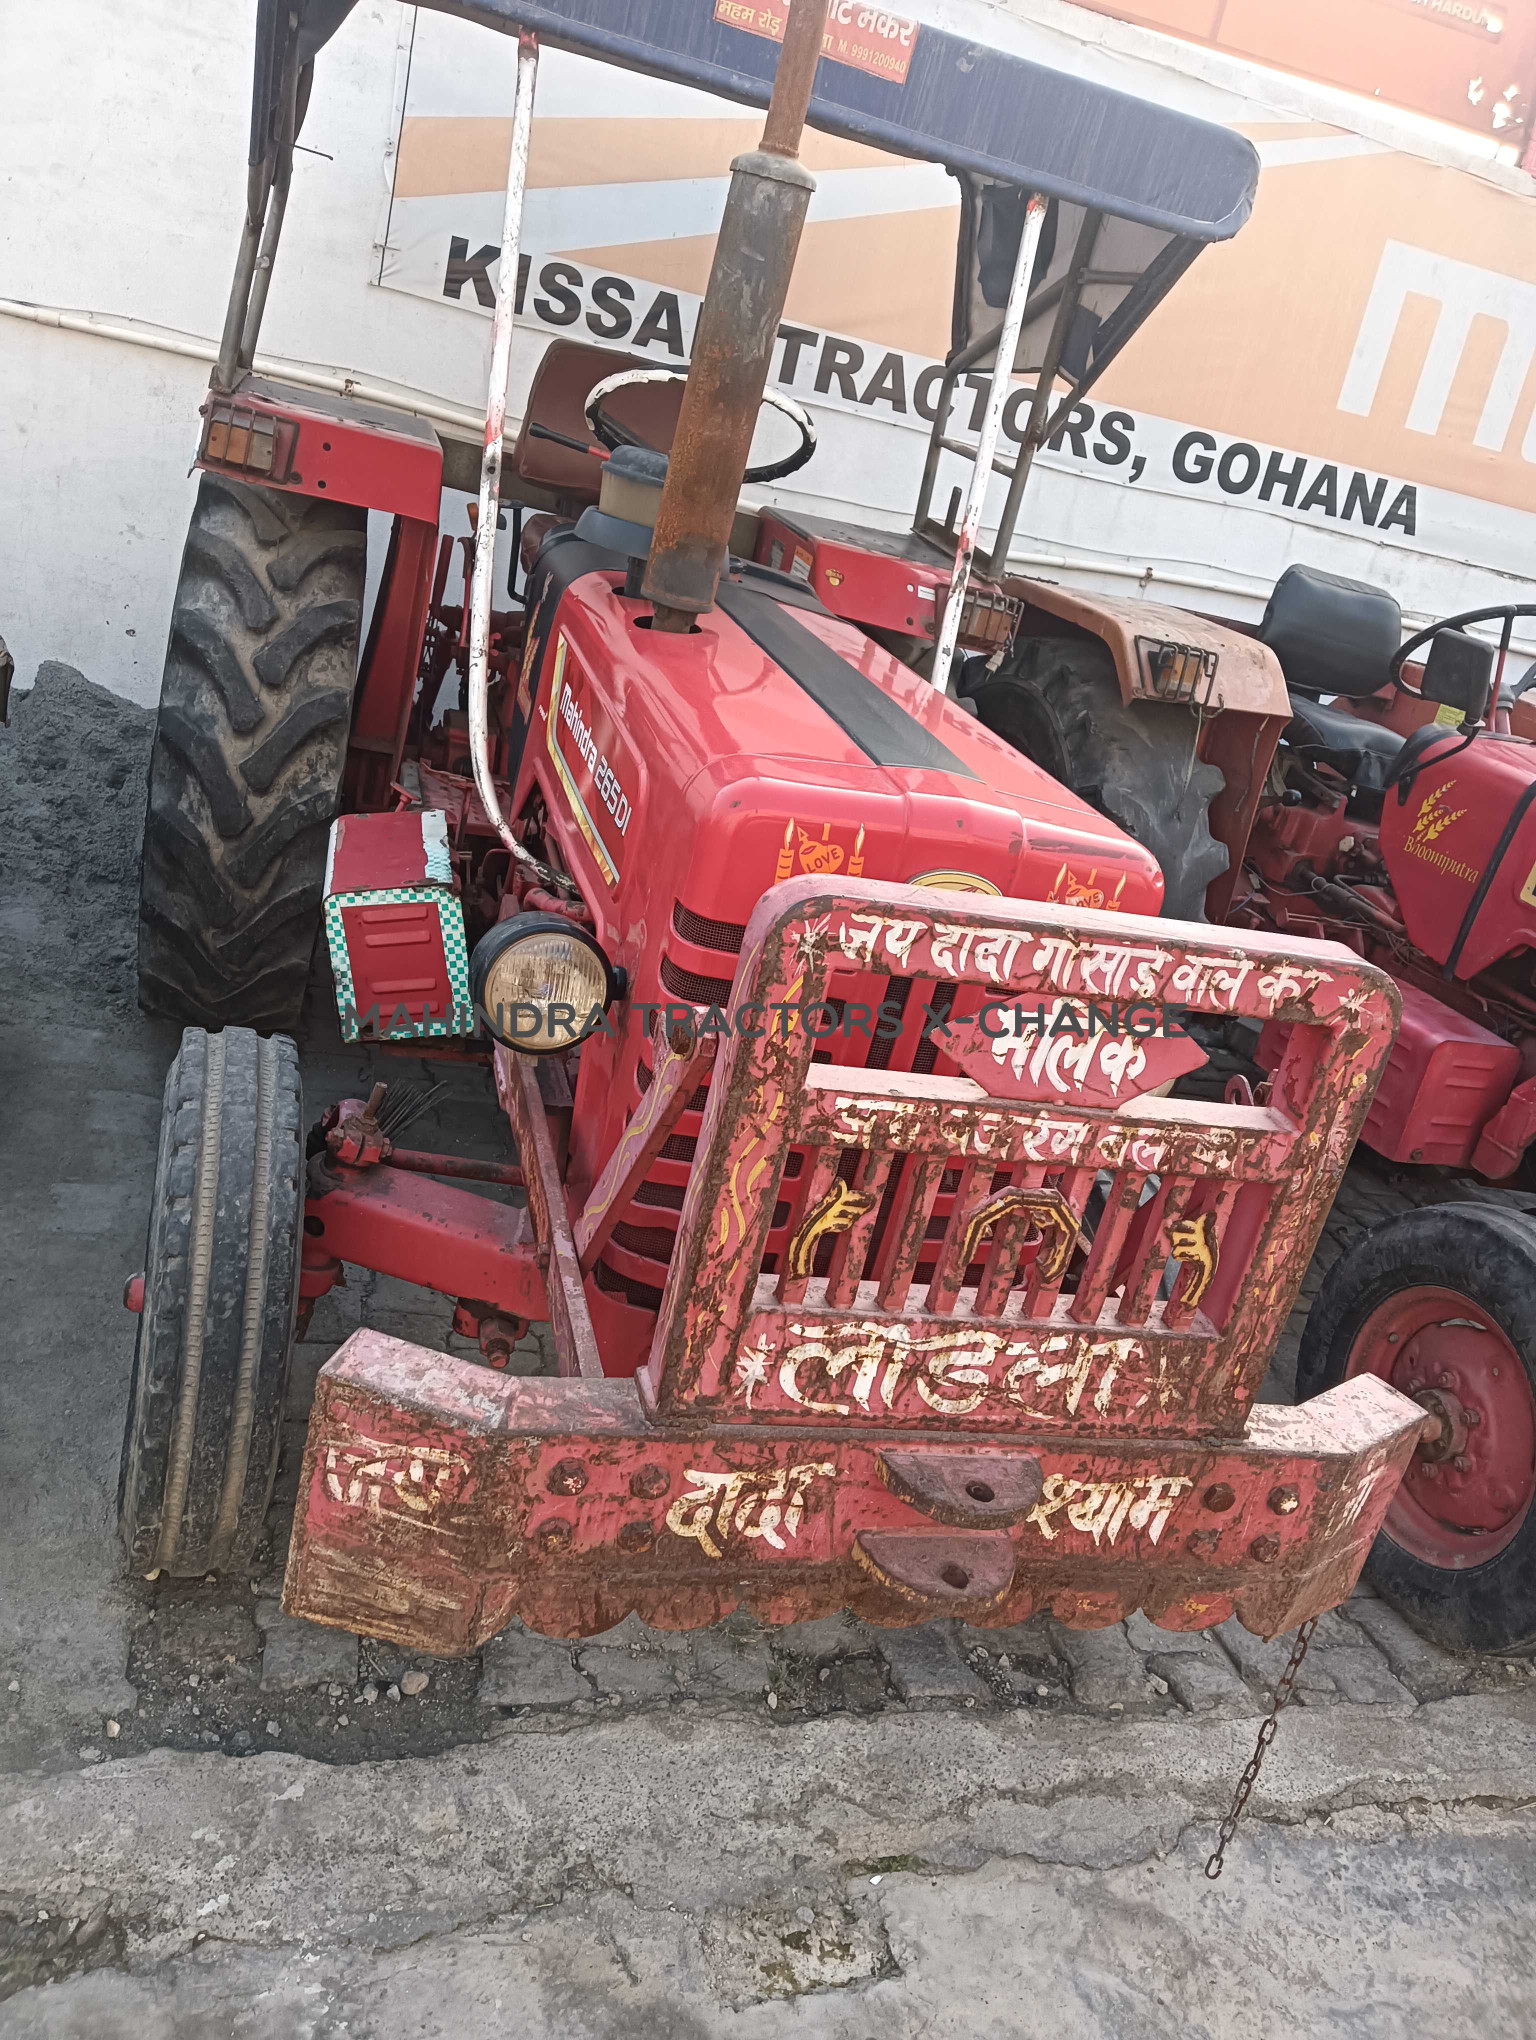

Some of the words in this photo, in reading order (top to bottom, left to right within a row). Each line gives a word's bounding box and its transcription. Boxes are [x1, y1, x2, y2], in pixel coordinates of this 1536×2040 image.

[838, 41, 849, 54] M.
[443, 235, 704, 360] KISSA
[1172, 431, 1418, 537] GOHANA
[806, 848, 840, 873] LOVE
[1077, 892, 1100, 908] OVE
[840, 913, 928, 968] जय
[930, 922, 1034, 983] दादा
[1026, 1473, 1193, 1546] श्याम
